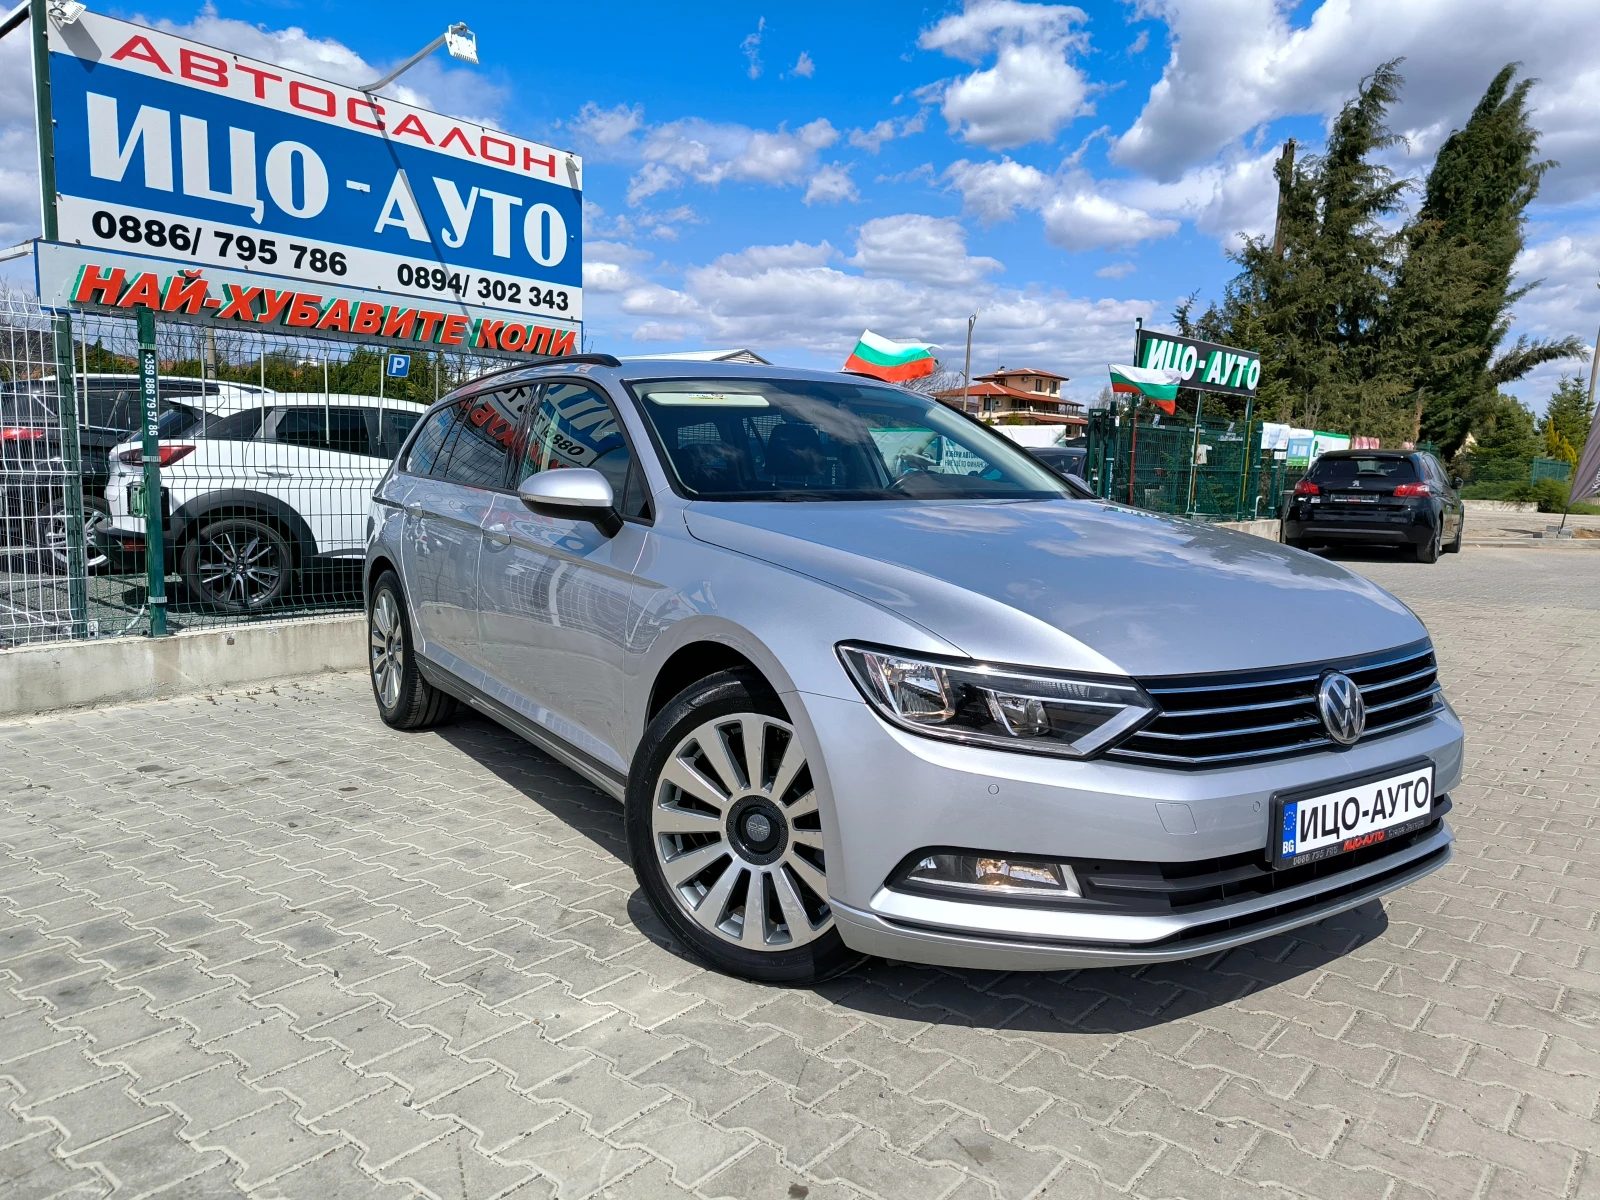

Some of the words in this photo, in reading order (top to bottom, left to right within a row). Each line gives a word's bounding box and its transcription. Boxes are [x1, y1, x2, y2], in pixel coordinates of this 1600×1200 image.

[110, 35, 555, 178] АВТОСАЛОН
[91, 211, 202, 256] 0886/
[213, 231, 278, 265] 795
[289, 243, 348, 276] 786
[397, 263, 470, 297] 0894/
[477, 277, 521, 304] 302
[528, 286, 569, 311] 343
[73, 263, 469, 345] НАЙ-ХУБАВИТЕ
[473, 318, 577, 356] КОЛИ
[144, 353, 155, 375] +359
[145, 378, 155, 394] 886
[146, 397, 156, 408] 79
[147, 411, 157, 422] 57
[148, 425, 158, 436] 86
[1300, 776, 1429, 843] ИЦО-АУТО
[1282, 839, 1295, 854] BG
[1343, 830, 1385, 852] ИЦО-АУТО
